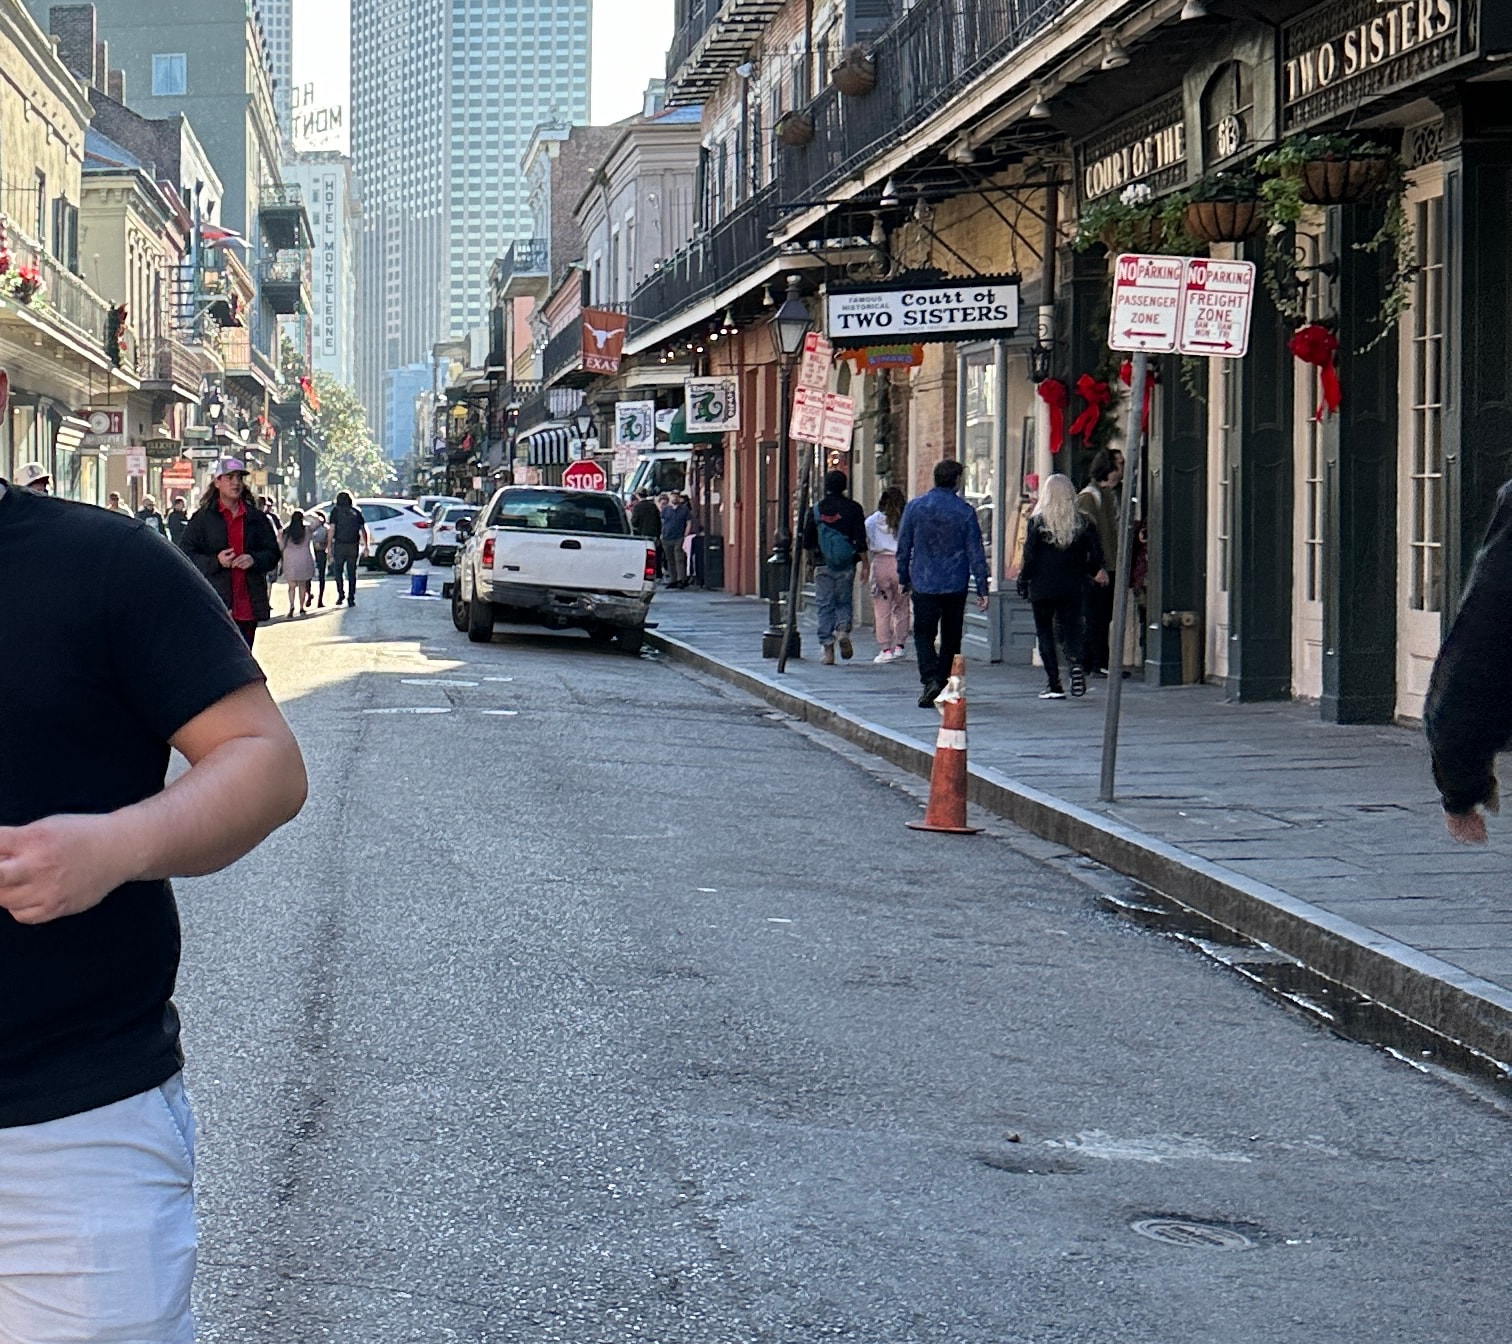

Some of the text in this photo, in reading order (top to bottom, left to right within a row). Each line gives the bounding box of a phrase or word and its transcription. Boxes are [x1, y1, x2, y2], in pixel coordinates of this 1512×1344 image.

[1287, 0, 1452, 102] TWO SISTERS
[1085, 122, 1185, 199] COURT OF THE
[324, 181, 335, 348] HOTEL MONTELEONE
[1118, 261, 1181, 281] NO PARKING
[1187, 266, 1251, 285] NO PARKING
[901, 288, 995, 306] Court of
[1118, 294, 1176, 307] PASSENGER
[1189, 293, 1245, 308] FREIGHT
[837, 305, 1008, 329] TWO SISTERS
[1130, 312, 1160, 324] ZONE
[1197, 308, 1233, 323] ZONE
[586, 357, 619, 372] EXAS
[566, 473, 603, 491] STOP
